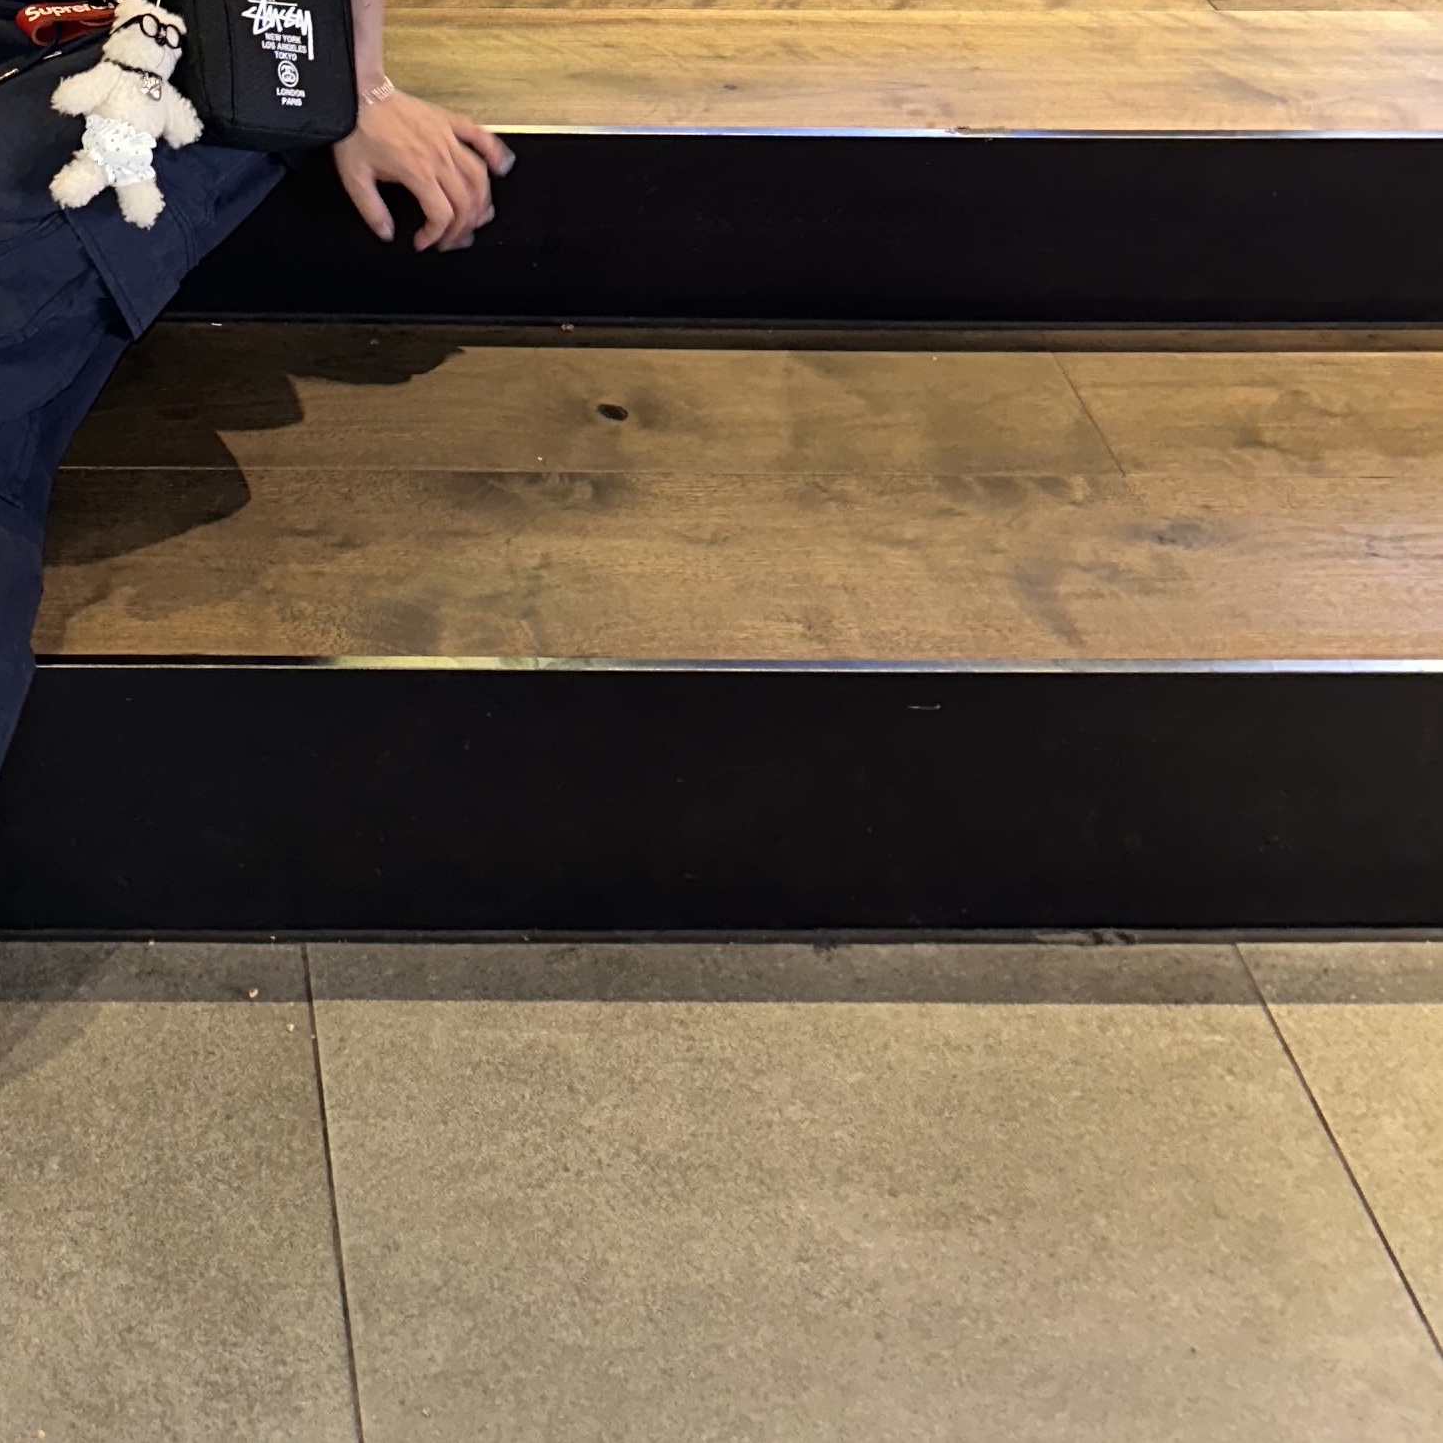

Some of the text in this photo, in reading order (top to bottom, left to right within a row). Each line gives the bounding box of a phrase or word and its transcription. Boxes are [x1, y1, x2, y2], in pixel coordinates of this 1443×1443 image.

[24, 3, 108, 22] Supre
[265, 32, 302, 44] NEW YORK
[261, 40, 276, 50] LOS
[274, 50, 298, 61] TOKYO
[276, 87, 306, 98] LONDON
[281, 97, 303, 107] PARIS
